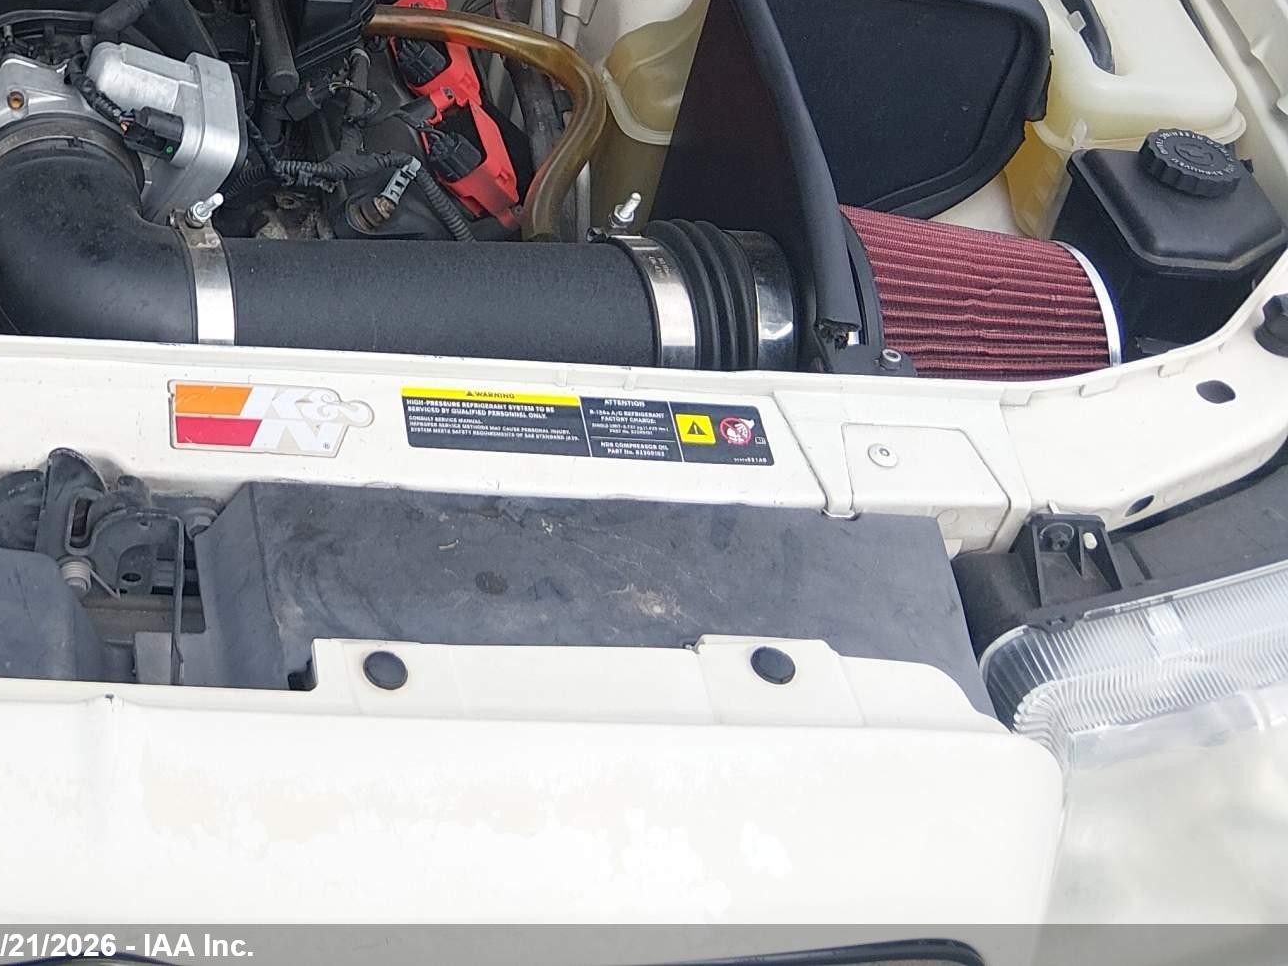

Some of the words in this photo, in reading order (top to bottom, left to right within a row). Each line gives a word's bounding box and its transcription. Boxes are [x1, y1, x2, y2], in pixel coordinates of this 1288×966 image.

[475, 391, 516, 399] WARNING
[406, 399, 461, 408] HIGH-PRESSURE
[461, 402, 507, 410] REFRIGERANT
[508, 404, 535, 412] SYSTEM
[604, 399, 646, 408] ATTENTION
[451, 408, 487, 416] QUALIFIED
[487, 410, 528, 418] PERSONNEL
